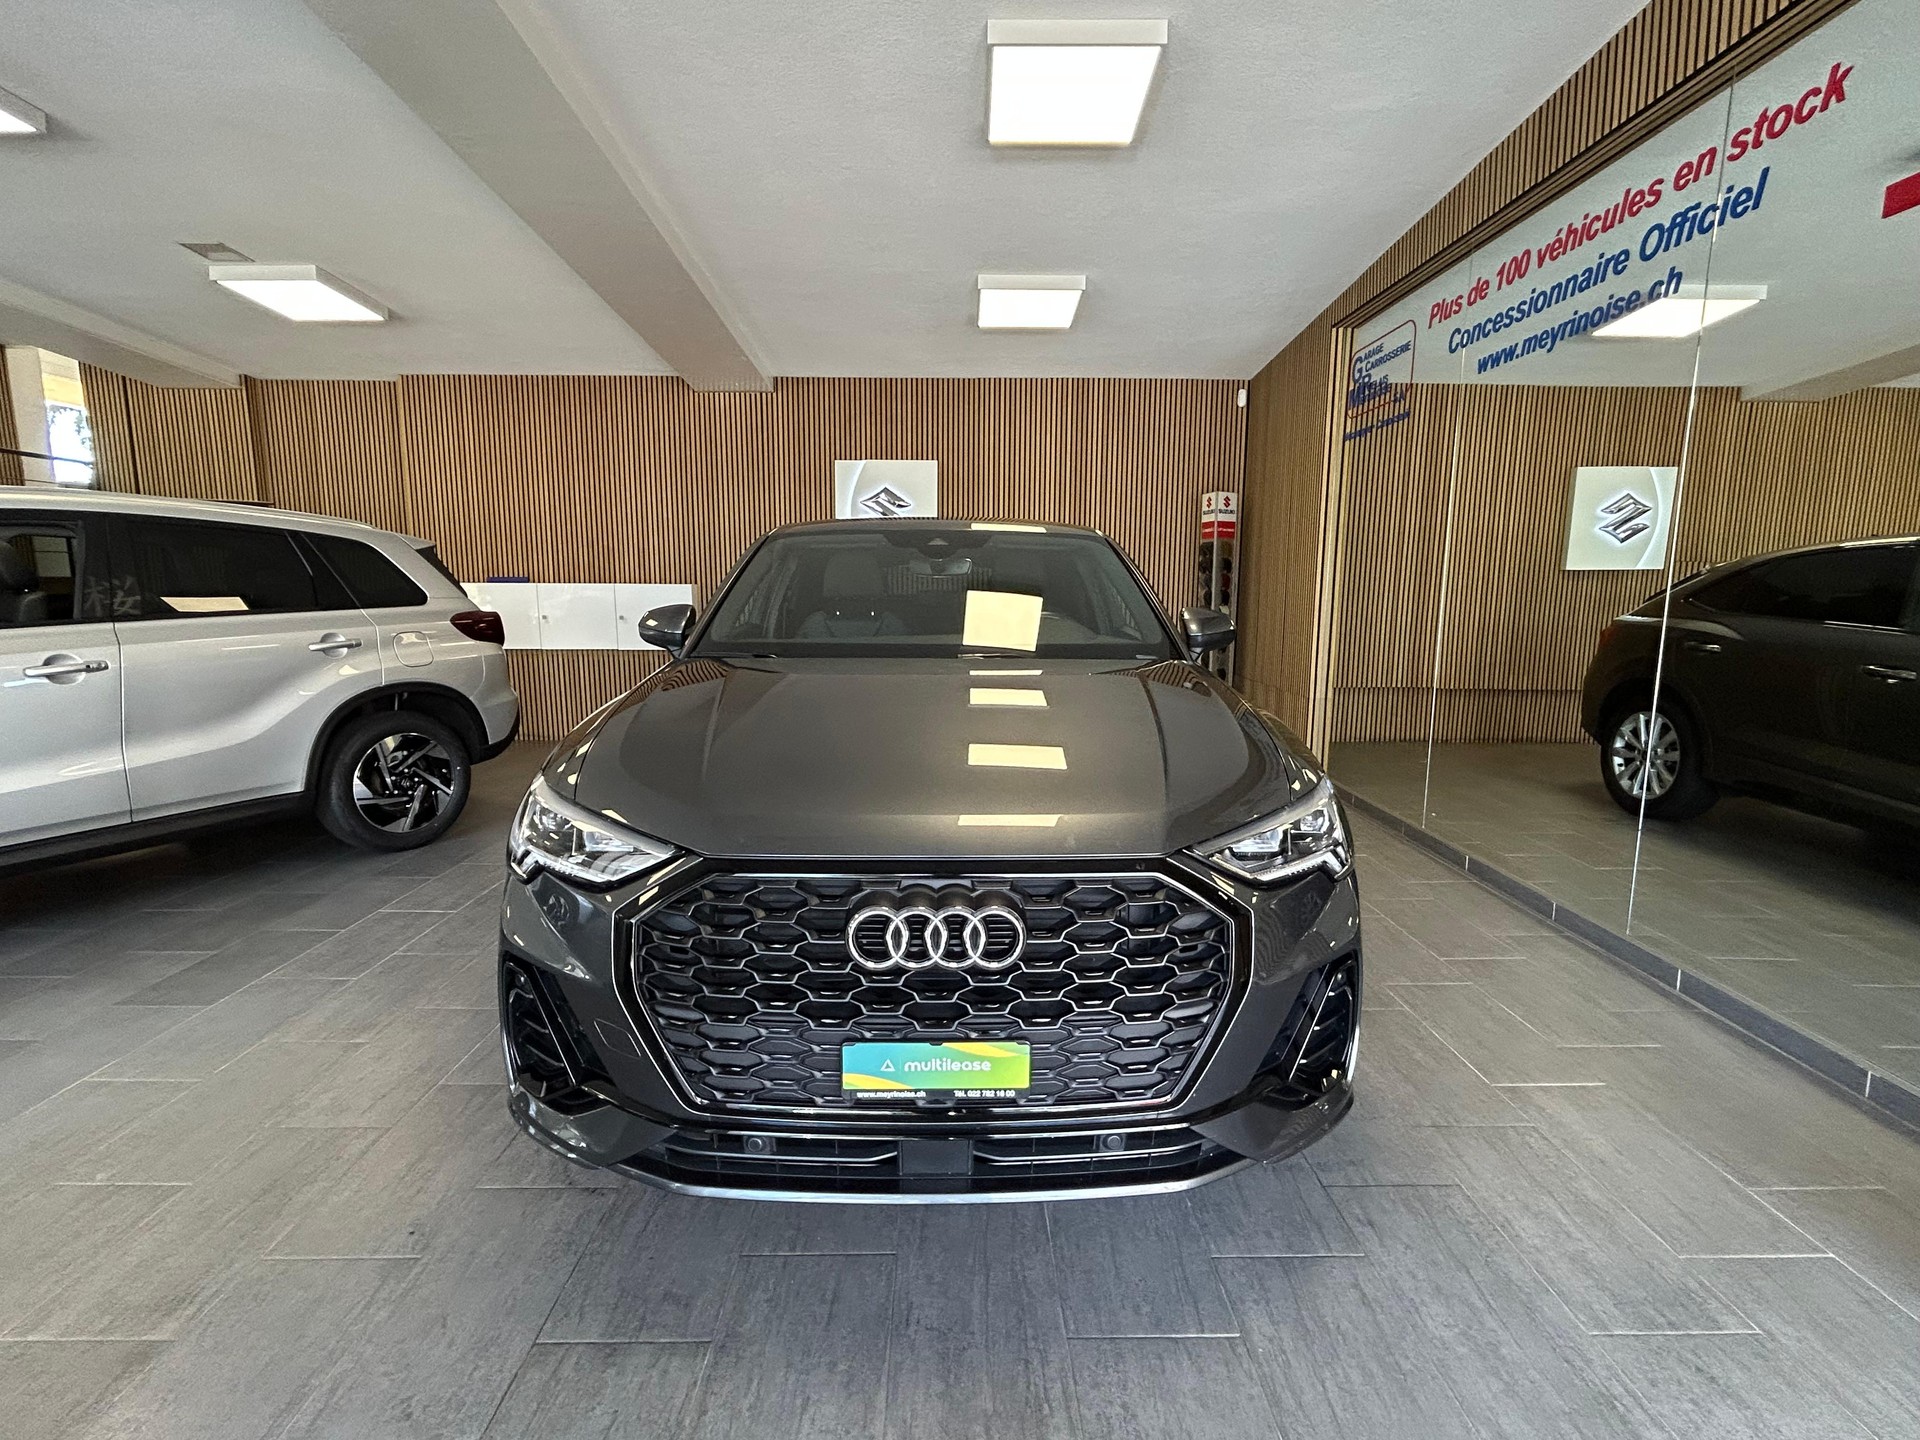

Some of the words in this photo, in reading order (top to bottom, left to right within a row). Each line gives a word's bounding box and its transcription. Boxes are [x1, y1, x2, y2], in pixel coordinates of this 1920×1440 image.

[1427, 294, 1463, 329] Plus
[1466, 277, 1490, 307] de
[1496, 249, 1531, 291] 100
[1537, 178, 1664, 268] véhicules
[1673, 146, 1717, 192] en
[1726, 61, 1855, 162] stock
[1448, 249, 1630, 354] Concessionnaire
[1638, 166, 1771, 262] Officiel
[1477, 266, 1683, 374] www.meyrinoise.ch
[904, 1058, 991, 1072] multilease
[967, 1090, 981, 1098] 022
[1005, 1090, 1016, 1098] 00
